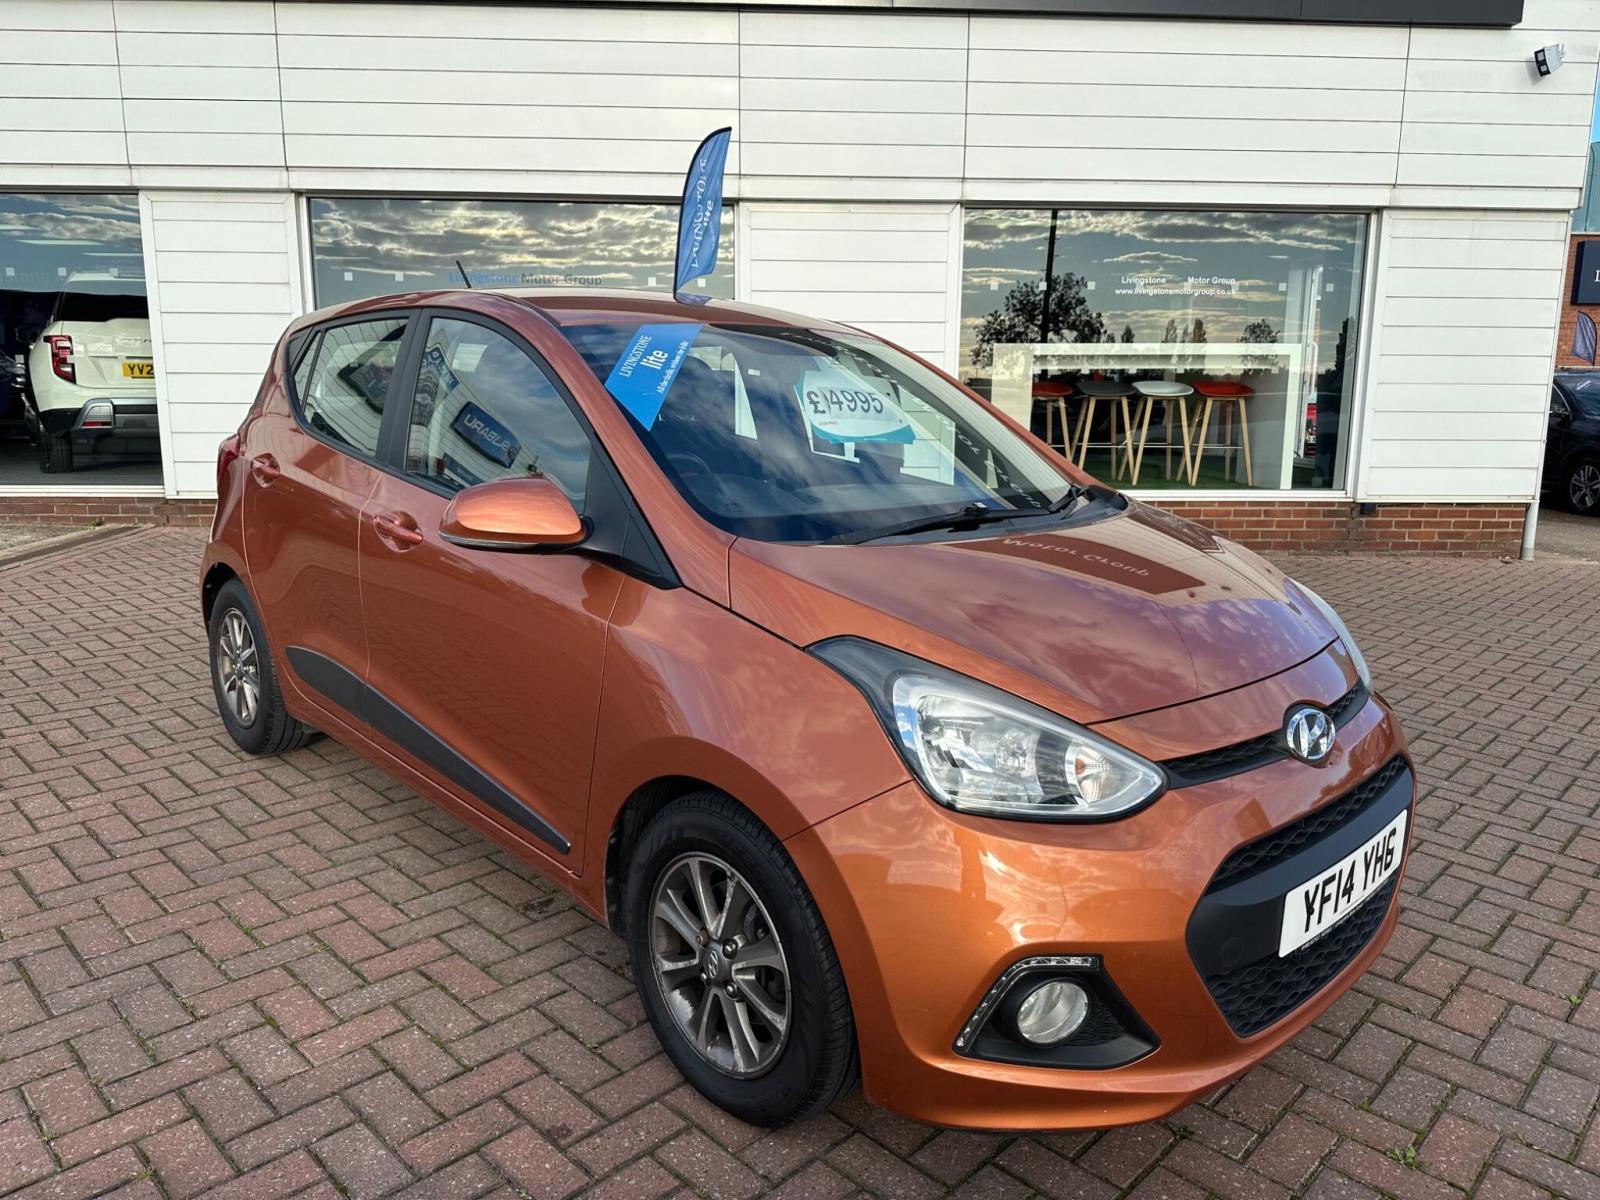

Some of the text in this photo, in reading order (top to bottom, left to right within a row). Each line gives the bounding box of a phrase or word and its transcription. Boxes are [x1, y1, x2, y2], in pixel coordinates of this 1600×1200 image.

[449, 272, 602, 286] Livngstone Motor Group
[1121, 276, 1237, 285] Livingstone Motor Group
[618, 335, 652, 378] LIVINGSTONE
[640, 350, 668, 370] lite
[128, 364, 154, 376] YV2
[1304, 860, 1356, 933] YF14
